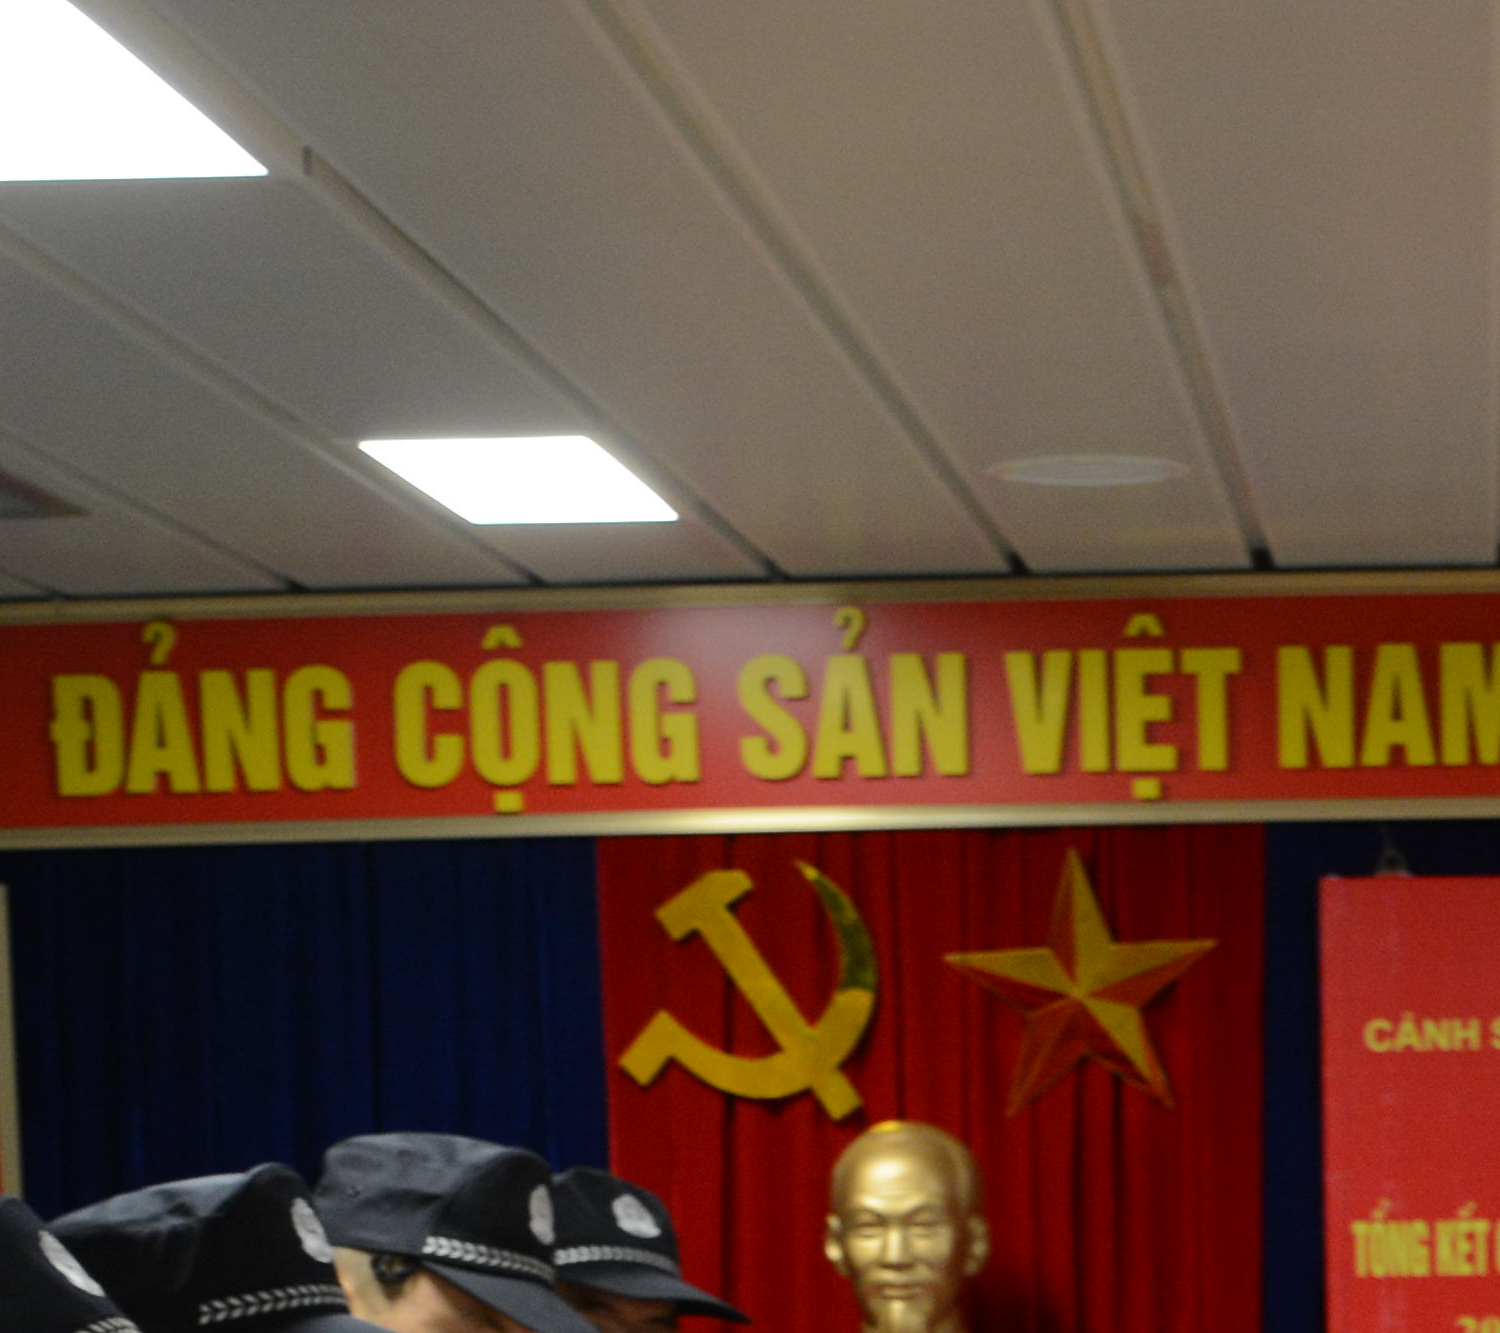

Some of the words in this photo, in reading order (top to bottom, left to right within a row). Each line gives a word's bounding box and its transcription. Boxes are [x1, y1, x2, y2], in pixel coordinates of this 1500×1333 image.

[52, 621, 356, 796] ĐẢNG
[394, 625, 701, 812] CỘNG
[736, 606, 970, 781] SẢN
[1003, 613, 1243, 800] VIỆT
